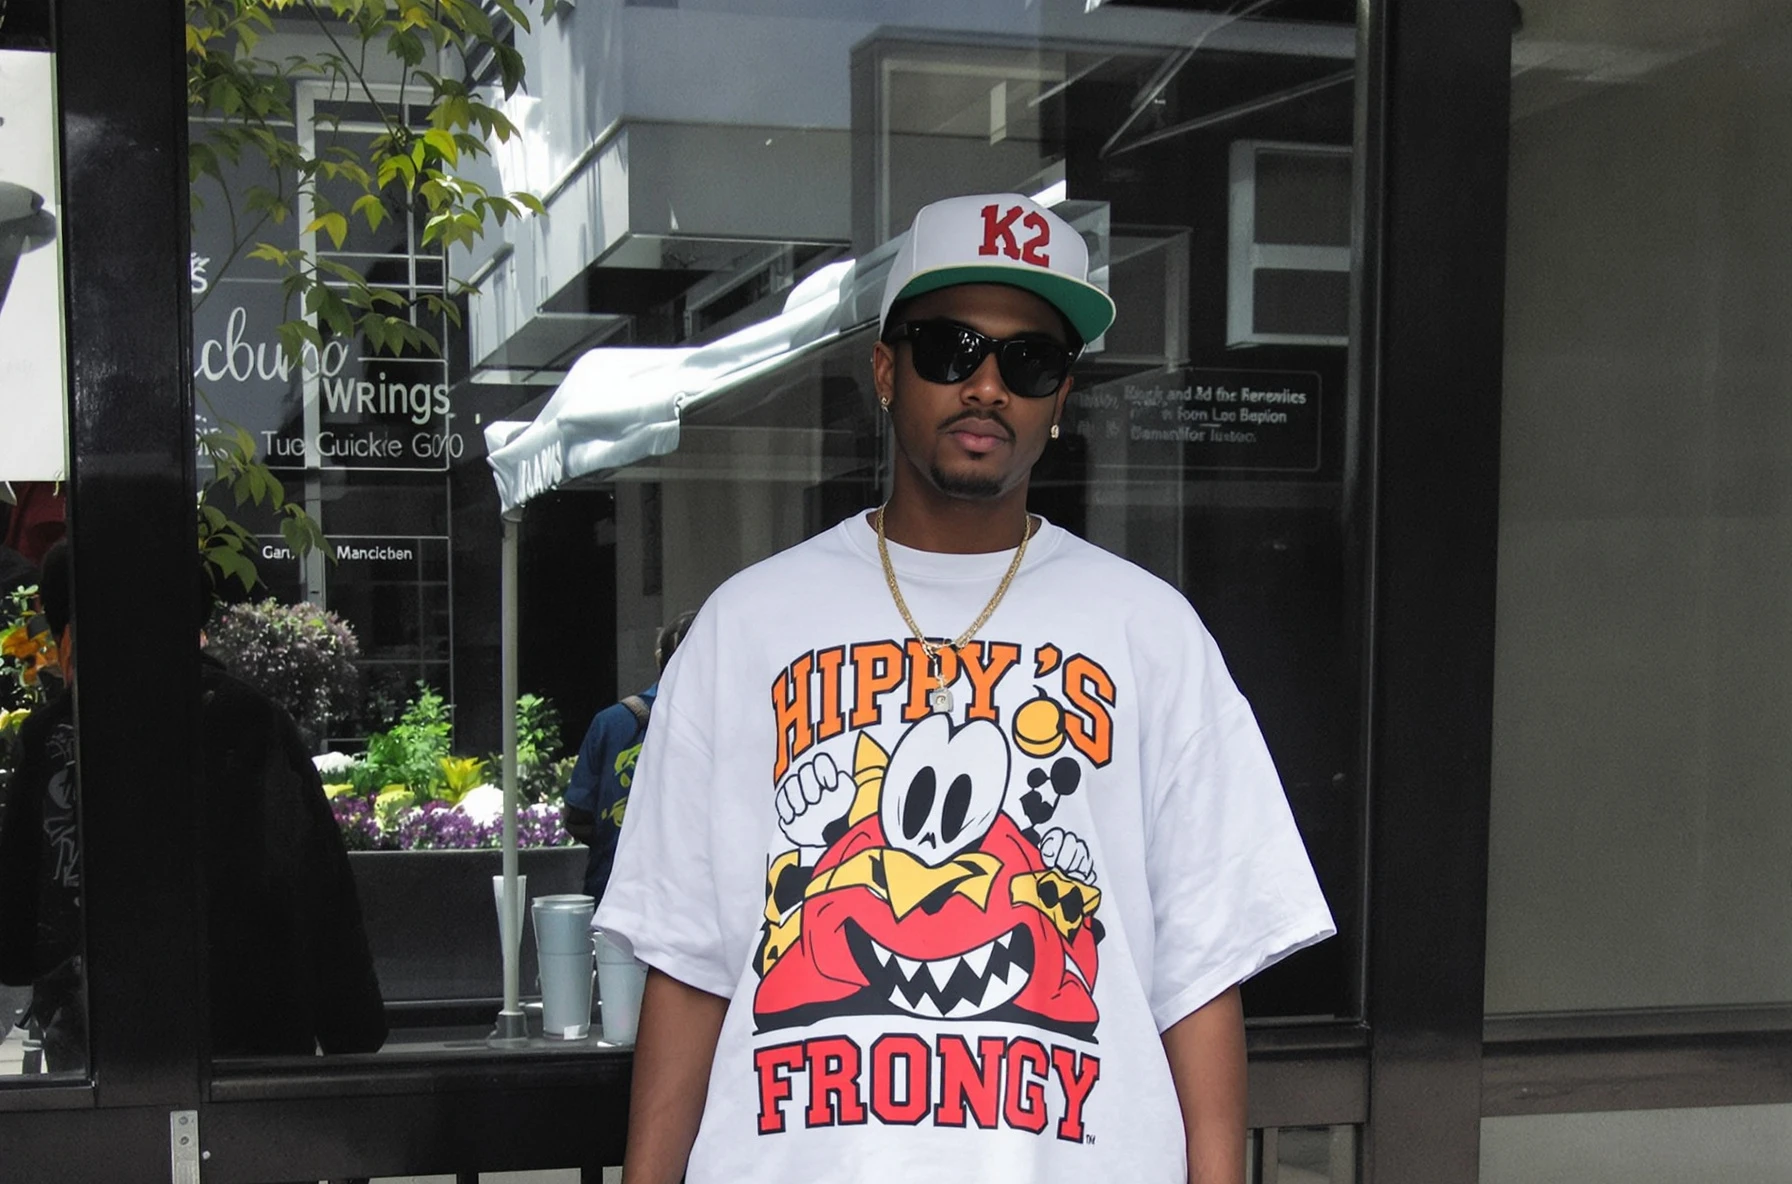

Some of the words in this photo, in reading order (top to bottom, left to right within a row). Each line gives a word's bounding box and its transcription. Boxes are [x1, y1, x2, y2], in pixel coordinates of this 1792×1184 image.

[978, 204, 1050, 268] K2
[771, 637, 1117, 790] HIPPY'S
[753, 1032, 1100, 1144] FRONGY
